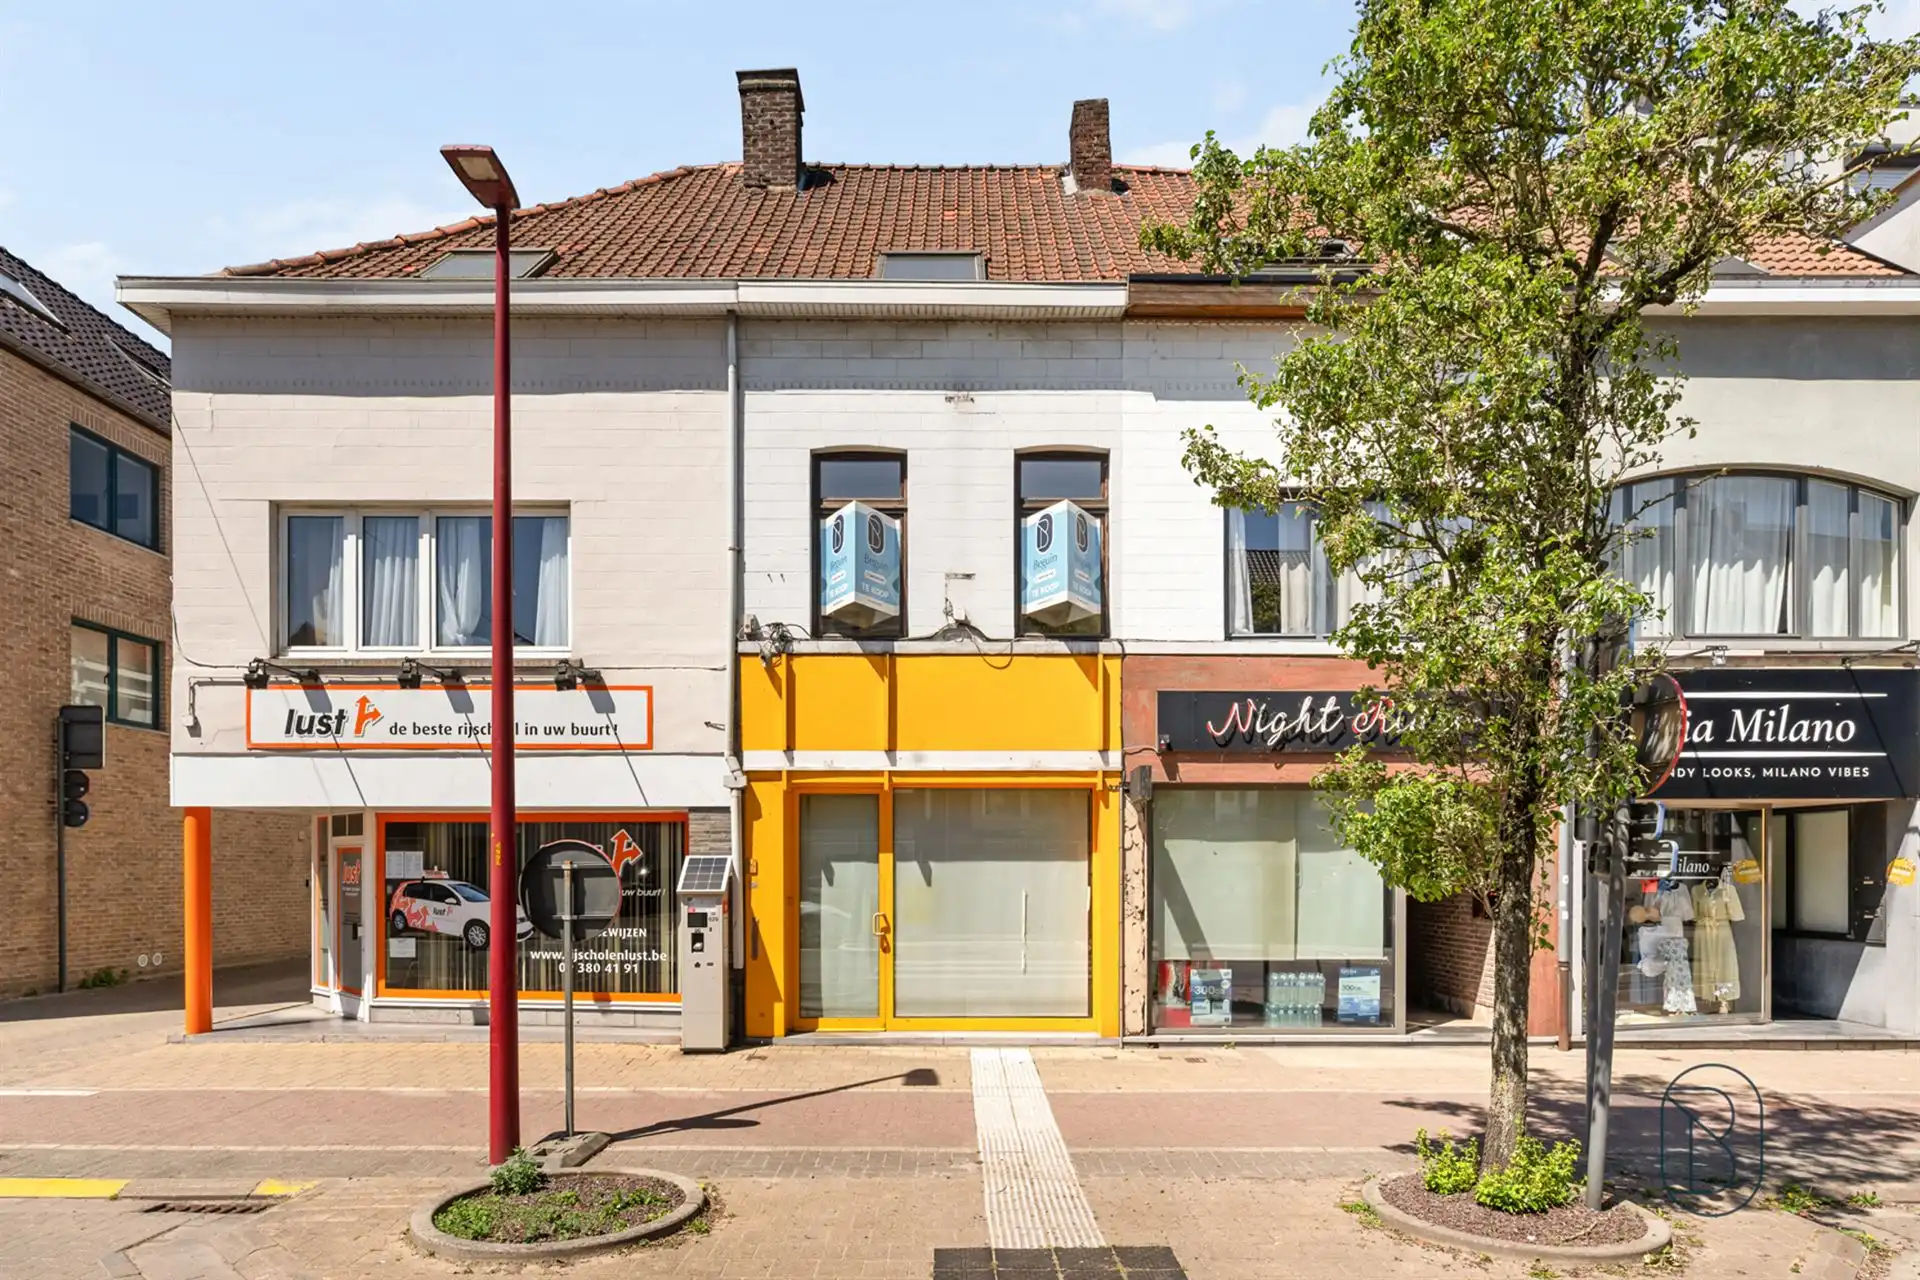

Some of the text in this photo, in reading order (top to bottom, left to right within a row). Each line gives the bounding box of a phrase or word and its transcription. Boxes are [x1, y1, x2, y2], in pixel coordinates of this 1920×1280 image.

[285, 709, 347, 735] lust
[1206, 695, 1344, 746] Night
[1683, 704, 1856, 743] ia Milano
[390, 722, 407, 735] de
[412, 722, 452, 735] beste
[458, 722, 519, 738] rijschl
[525, 722, 538, 735] in
[544, 725, 565, 735] uw
[1703, 767, 1756, 780] LOOKS,
[1762, 767, 1821, 778] MILANO
[1828, 767, 1870, 778] VIBES
[1678, 856, 1710, 873] ilano
[598, 927, 648, 940] EWIJZEN
[530, 948, 668, 962] www.jscholenlust.be
[577, 962, 601, 974] 380
[604, 963, 619, 974] 41
[624, 963, 638, 974] 91
